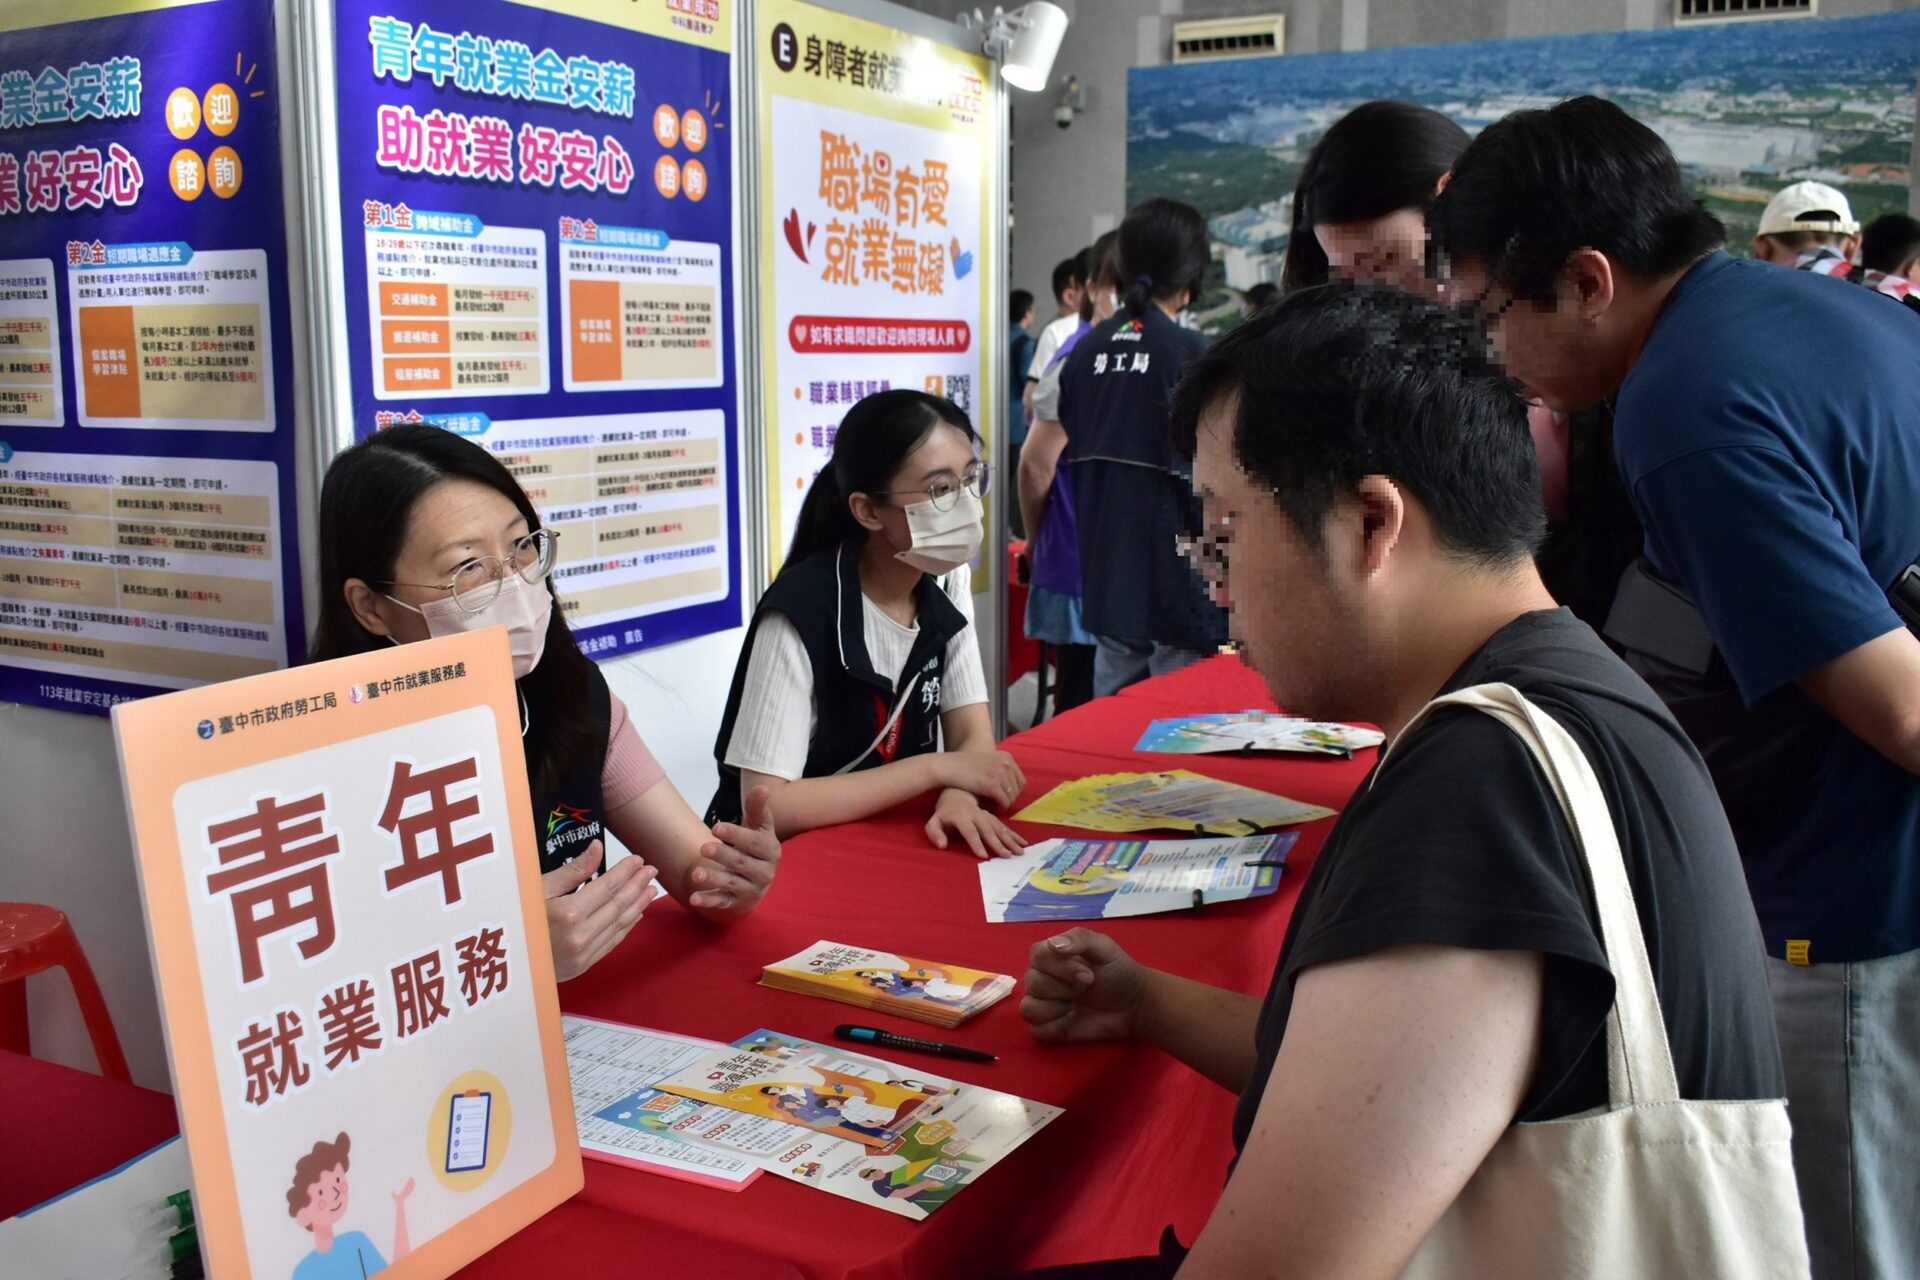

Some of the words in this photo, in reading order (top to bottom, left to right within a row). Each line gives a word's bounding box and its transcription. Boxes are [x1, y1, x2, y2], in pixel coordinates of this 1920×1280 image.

[369, 16, 635, 118] 青年就業金安薪
[779, 32, 791, 63] E
[0, 56, 142, 128] 業金安薪
[819, 129, 949, 229] 職場有愛
[363, 200, 413, 229] 第1金
[821, 217, 945, 297] 就業無礙
[1093, 352, 1150, 375] 勞工局
[366, 661, 467, 700] 臺中市就業服務處
[218, 691, 337, 735] 臺中市政府勞工局
[546, 820, 601, 855] 臺中市政府
[206, 755, 495, 985] 青年
[236, 926, 510, 1107] 就業服務
